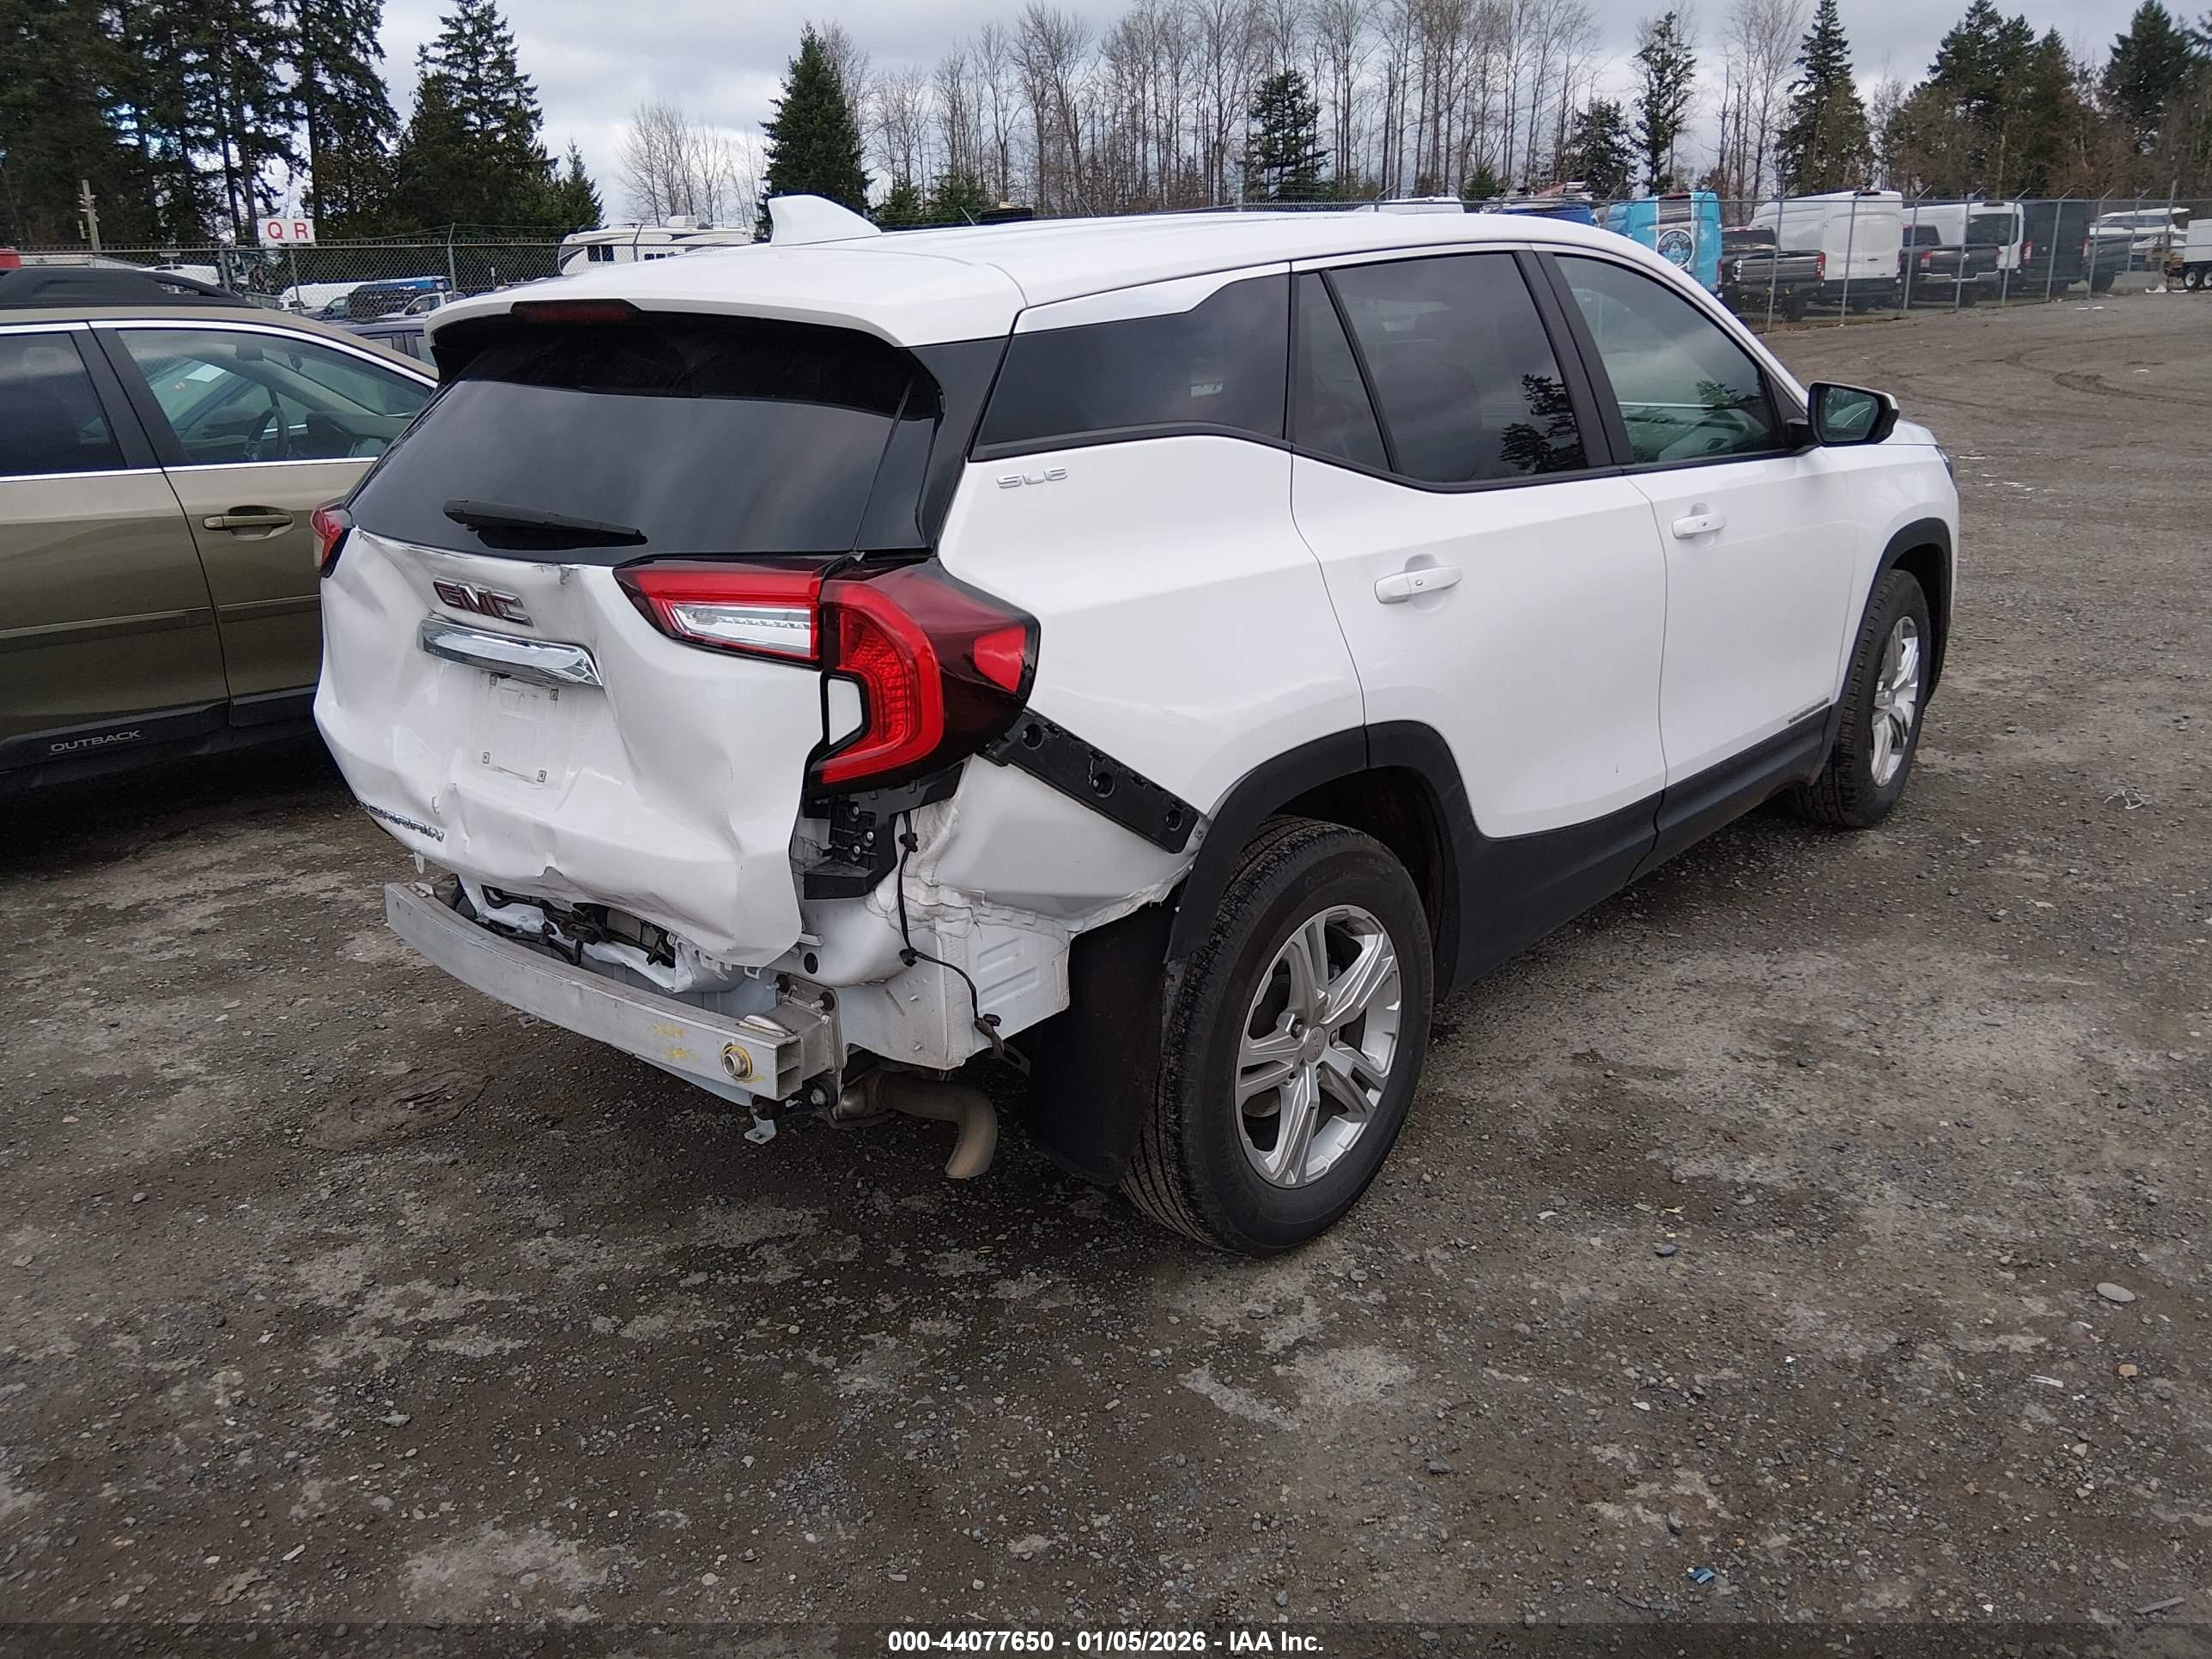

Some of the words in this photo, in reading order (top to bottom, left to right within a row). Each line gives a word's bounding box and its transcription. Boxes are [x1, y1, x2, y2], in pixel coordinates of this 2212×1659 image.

[267, 222, 284, 240] Q
[294, 222, 308, 240] R
[996, 466, 1068, 489] SLE
[433, 577, 534, 628] GMC
[50, 730, 143, 753] OUTBACK
